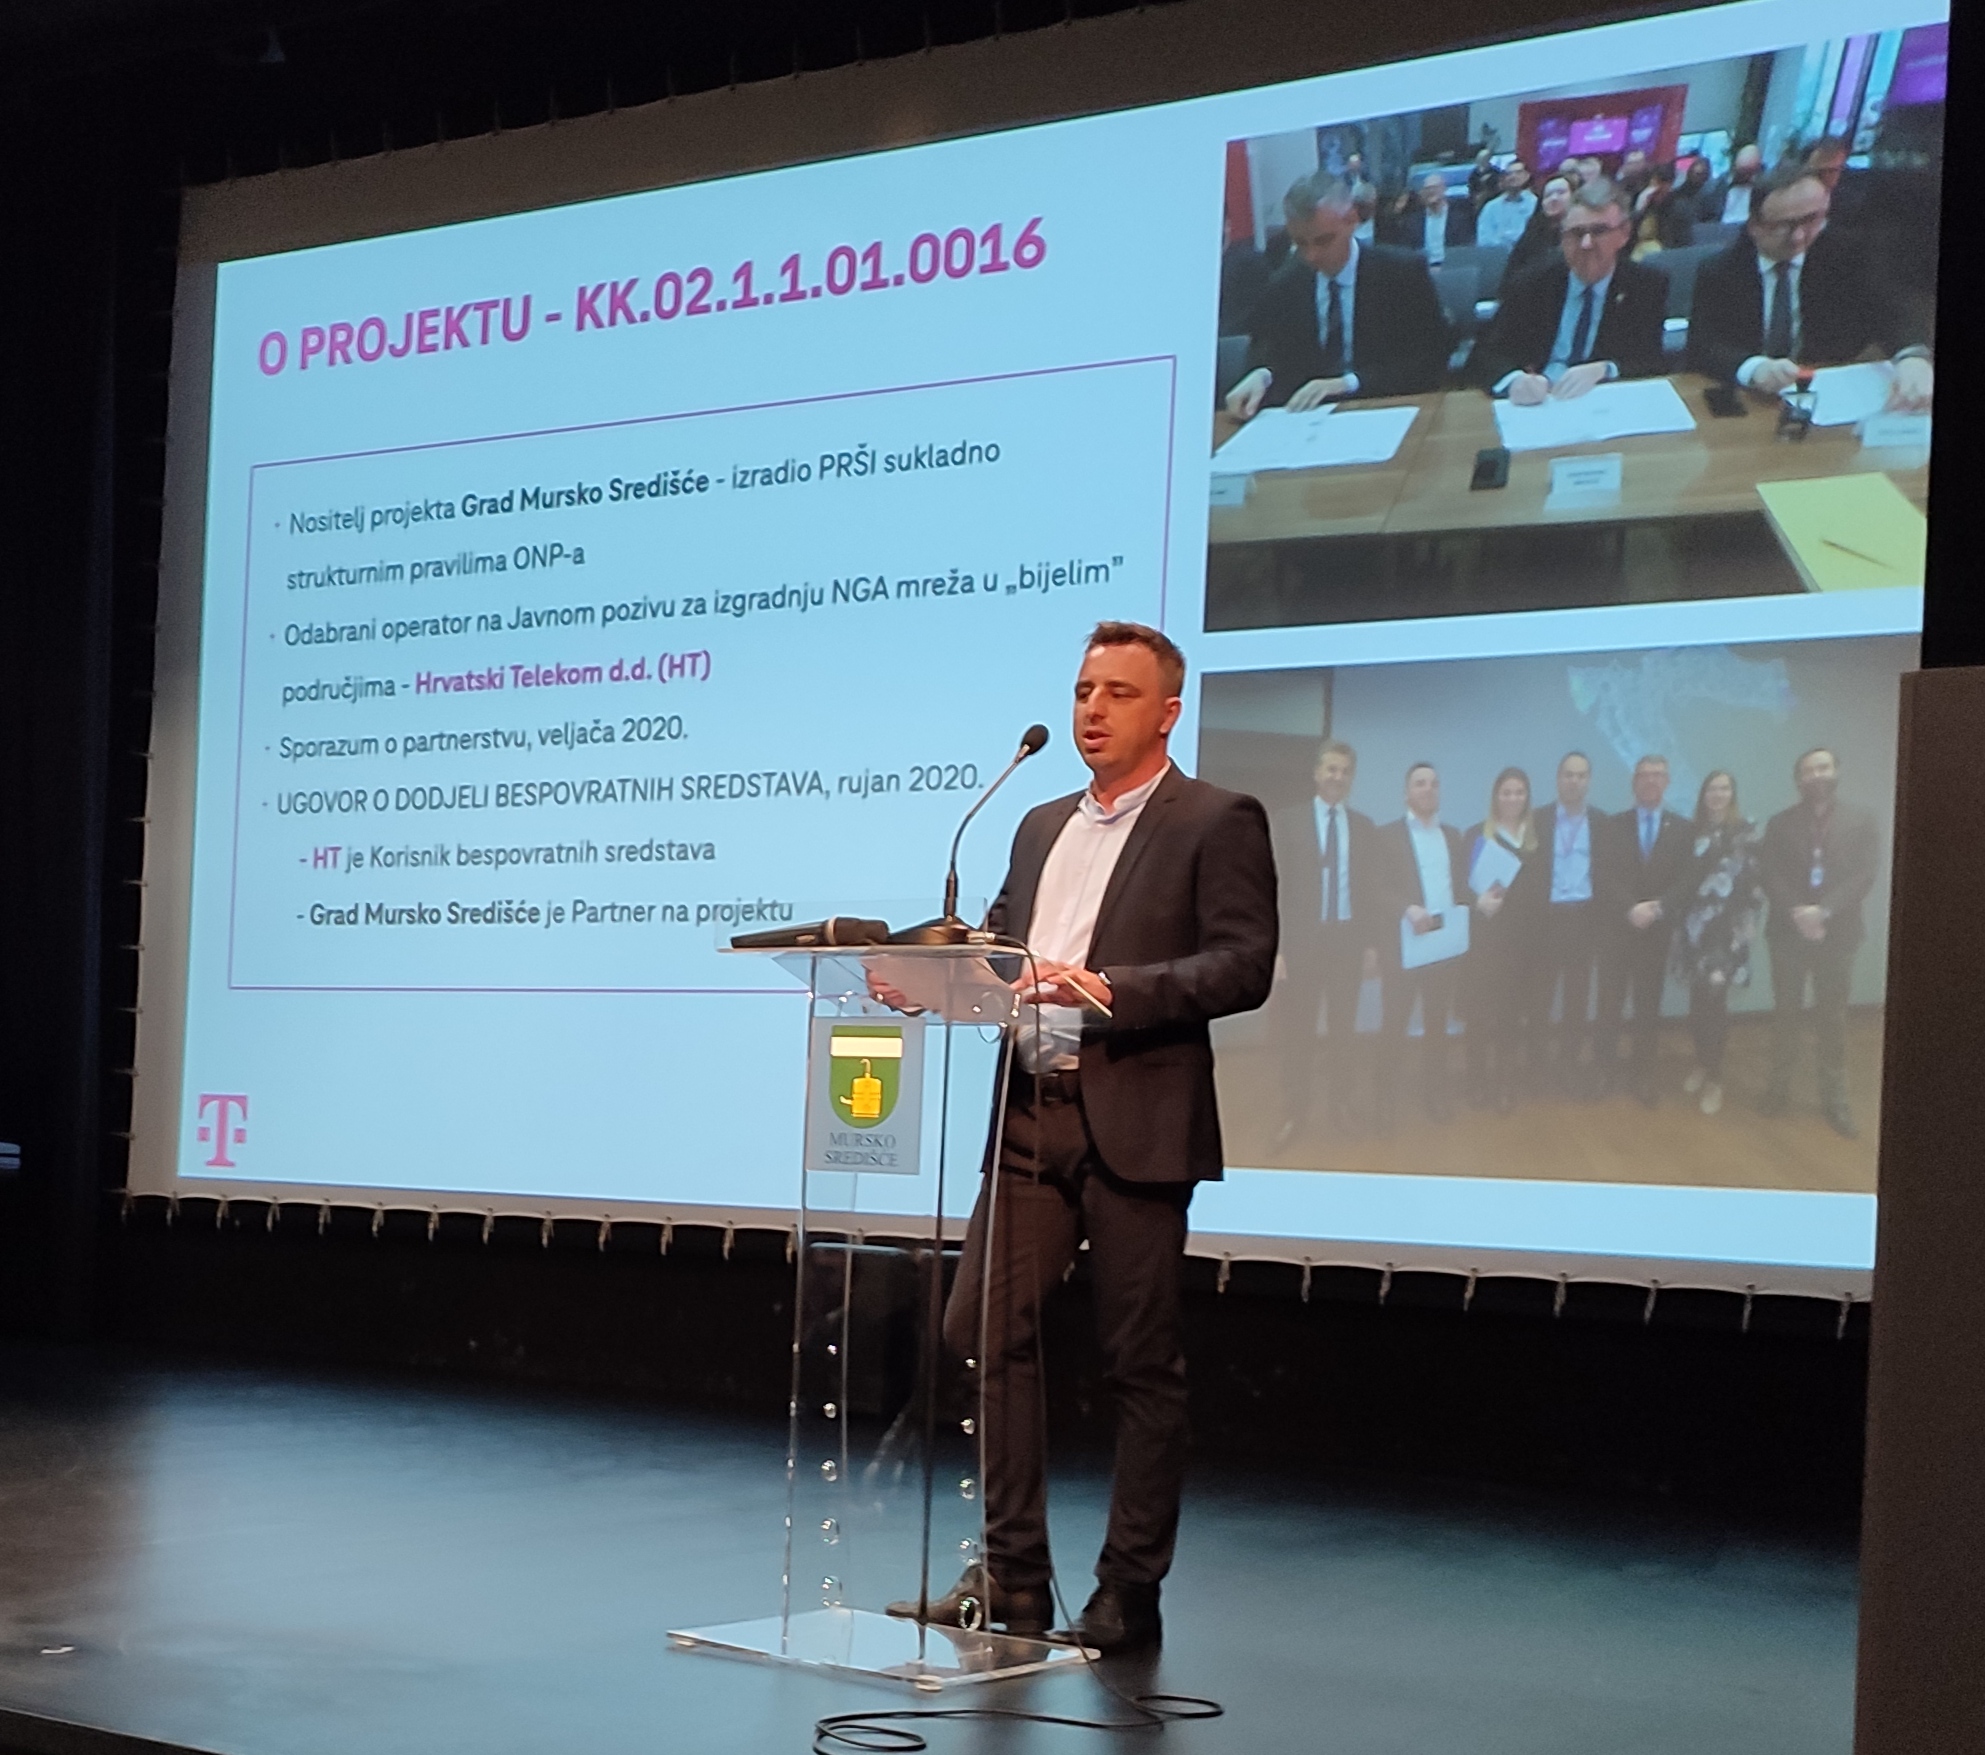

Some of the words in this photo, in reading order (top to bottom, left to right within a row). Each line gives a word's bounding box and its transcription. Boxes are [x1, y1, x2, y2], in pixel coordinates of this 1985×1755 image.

[258, 330, 289, 377] O
[298, 293, 533, 372] PROJEKTU
[575, 216, 1048, 333] KK.02.1.1.01.0016
[289, 505, 365, 535] Nositelj
[370, 498, 456, 532] projekta
[460, 489, 515, 518] Grad
[519, 481, 604, 512] Mursko
[608, 468, 710, 503] Središće
[731, 458, 812, 490] izradio
[818, 442, 877, 481] PRŠI
[883, 439, 1001, 474] sukladno
[286, 559, 405, 591] strukturnim
[409, 551, 508, 586] pravilima
[513, 542, 586, 571] ONP-a
[284, 617, 377, 647] Odabrani
[381, 614, 473, 644] operator
[476, 613, 503, 633] na
[506, 605, 596, 631] Javnom
[601, 595, 676, 629] pozivu
[680, 596, 708, 617] za
[713, 581, 825, 619] izgradnju
[831, 575, 890, 605] NGA
[895, 567, 976, 600] mreža
[982, 573, 999, 593] u
[282, 675, 397, 708] područjima
[415, 665, 505, 695] Hrvatski
[508, 661, 604, 689] Telekom
[608, 655, 653, 683] d.d.
[657, 649, 712, 685] (HT)
[279, 736, 380, 763] Sporazum
[384, 736, 398, 754] o
[402, 728, 533, 759] partnerstvu,
[537, 718, 616, 751] veljača
[621, 714, 689, 743] 2020.
[277, 789, 368, 815] UGOVOR
[372, 788, 390, 812] O
[395, 784, 489, 812] DODJELI
[495, 776, 674, 808] BESPOVRATNIH
[680, 769, 831, 801] SREDSTAVA,
[837, 768, 901, 800] rujan
[908, 764, 984, 792] 2020.
[312, 845, 343, 870] HT
[344, 847, 365, 874] je
[369, 843, 451, 868] Korisnik
[456, 839, 598, 871] bespovratnih
[604, 837, 716, 863] sredstava
[309, 902, 360, 926] Grad
[364, 901, 442, 926] Mursko
[446, 899, 541, 925] Središće
[543, 900, 566, 930] je
[571, 898, 657, 924] Partner
[661, 904, 690, 923] na
[696, 897, 793, 926] projektu
[829, 1132, 896, 1148] MURSKO
